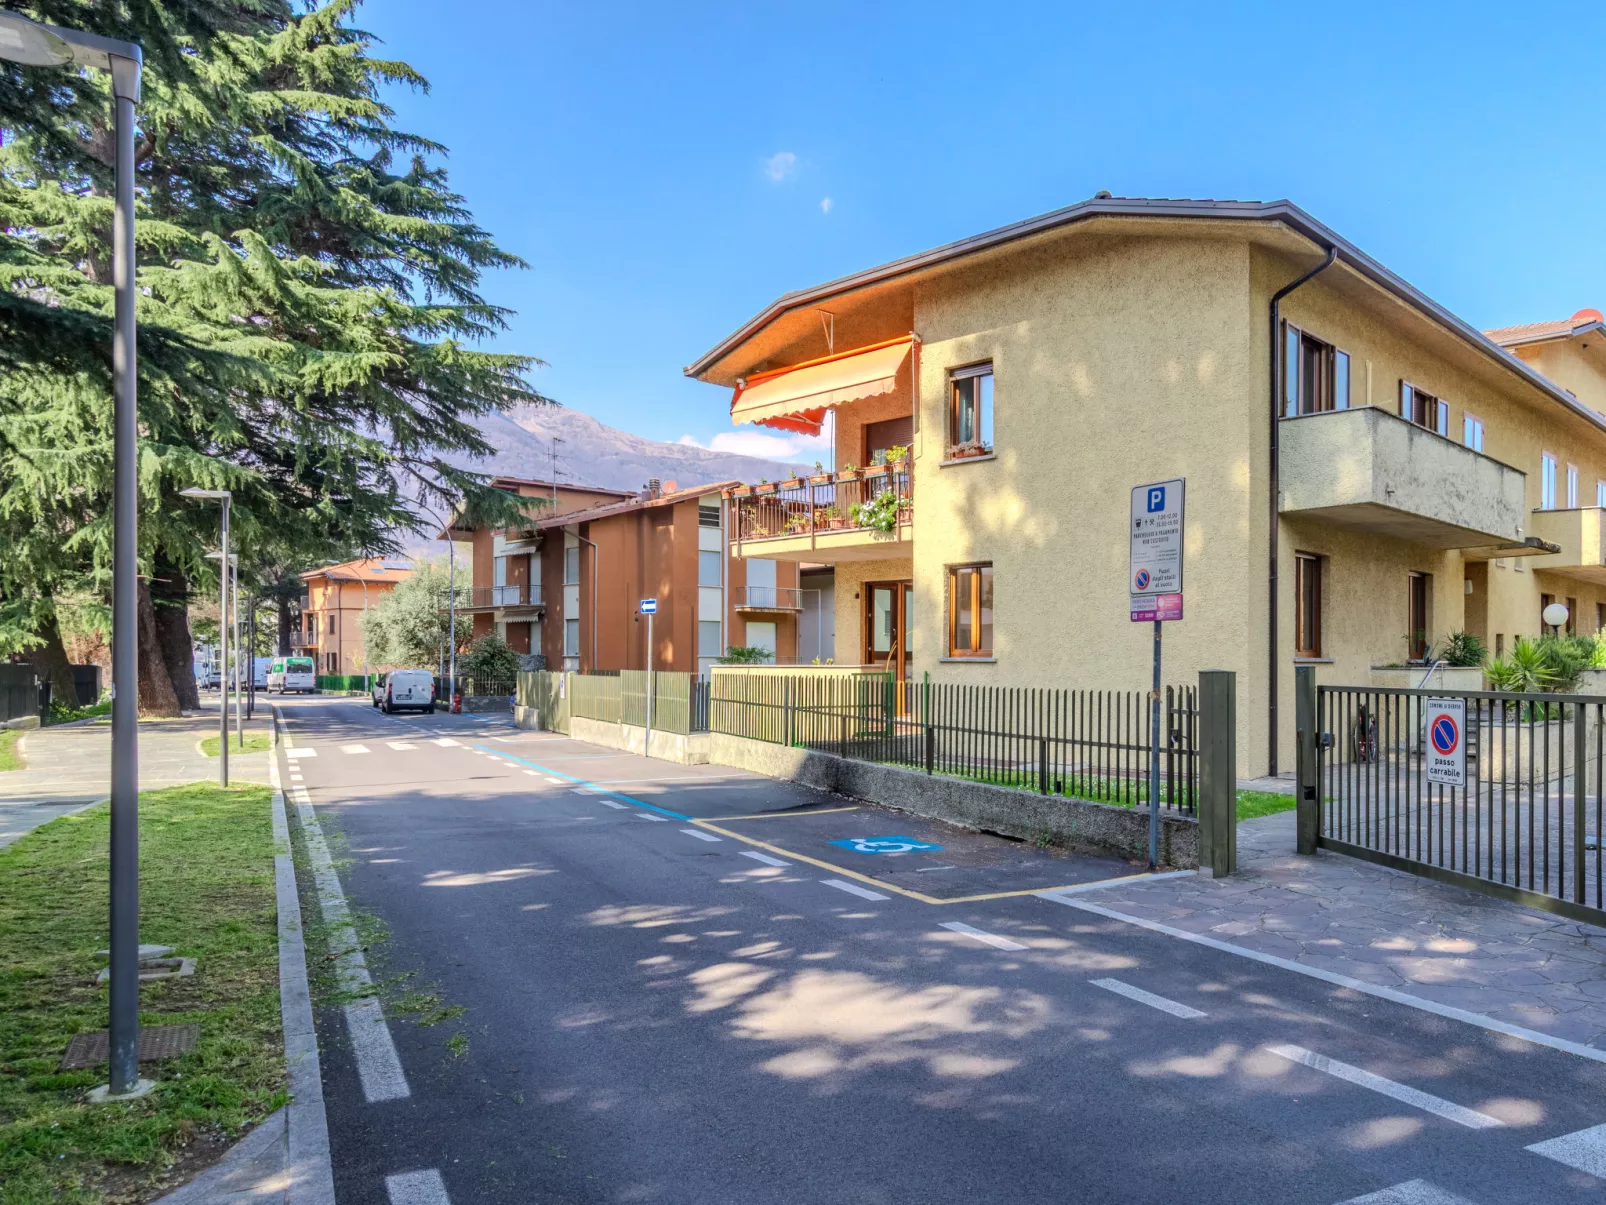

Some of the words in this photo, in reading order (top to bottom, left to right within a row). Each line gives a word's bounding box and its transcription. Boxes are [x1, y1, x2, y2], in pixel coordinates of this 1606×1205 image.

[1151, 491, 1162, 510] P
[1435, 758, 1455, 766] passo
[1429, 767, 1461, 778] carrabile
